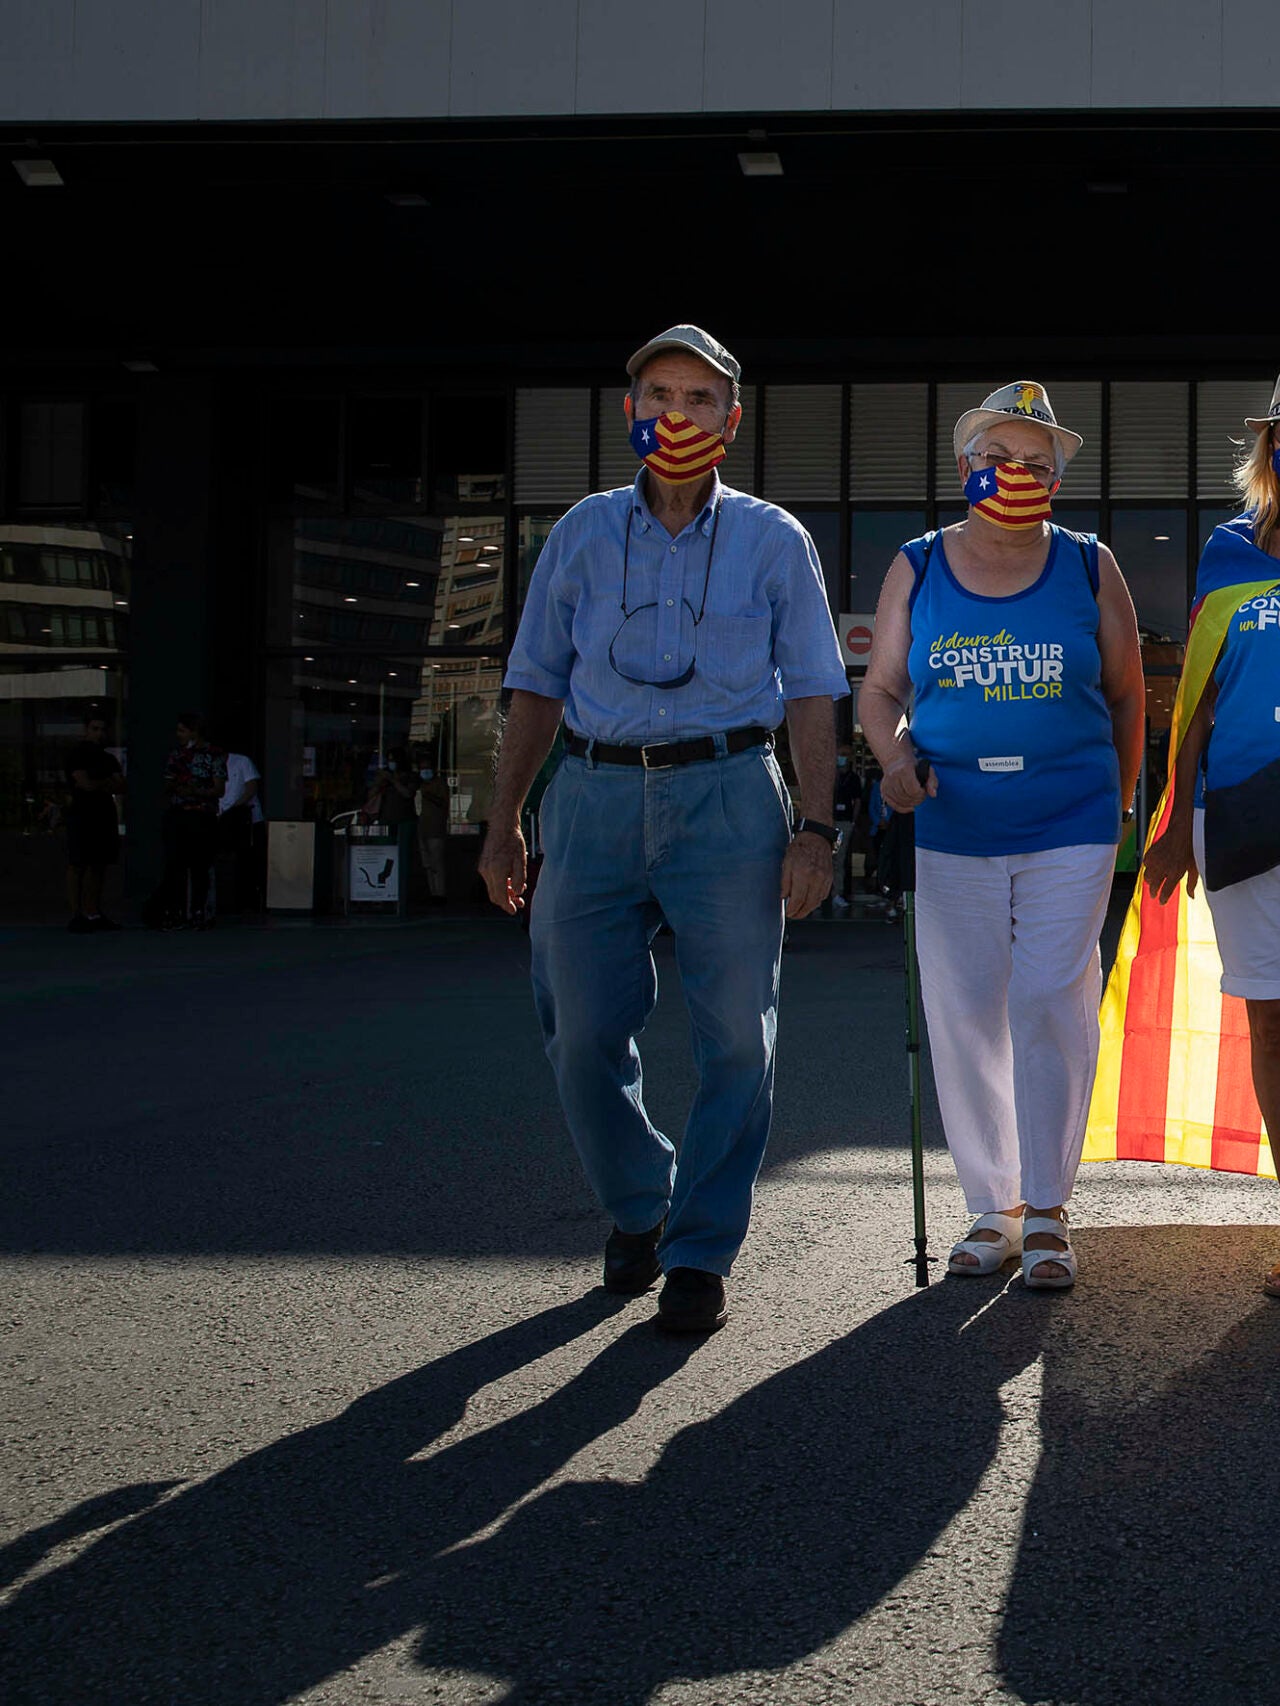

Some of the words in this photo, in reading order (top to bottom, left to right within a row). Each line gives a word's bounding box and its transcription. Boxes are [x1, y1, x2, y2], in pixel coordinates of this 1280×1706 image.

[1239, 620, 1258, 632] un
[930, 634, 946, 653] el
[944, 631, 992, 650] deure
[993, 628, 1016, 646] de
[928, 643, 1064, 669] CONSTRUIR
[938, 677, 957, 689] un
[954, 660, 1064, 688] FUTUR
[984, 682, 1063, 702] MILLOR
[985, 759, 1019, 768] assemblea
